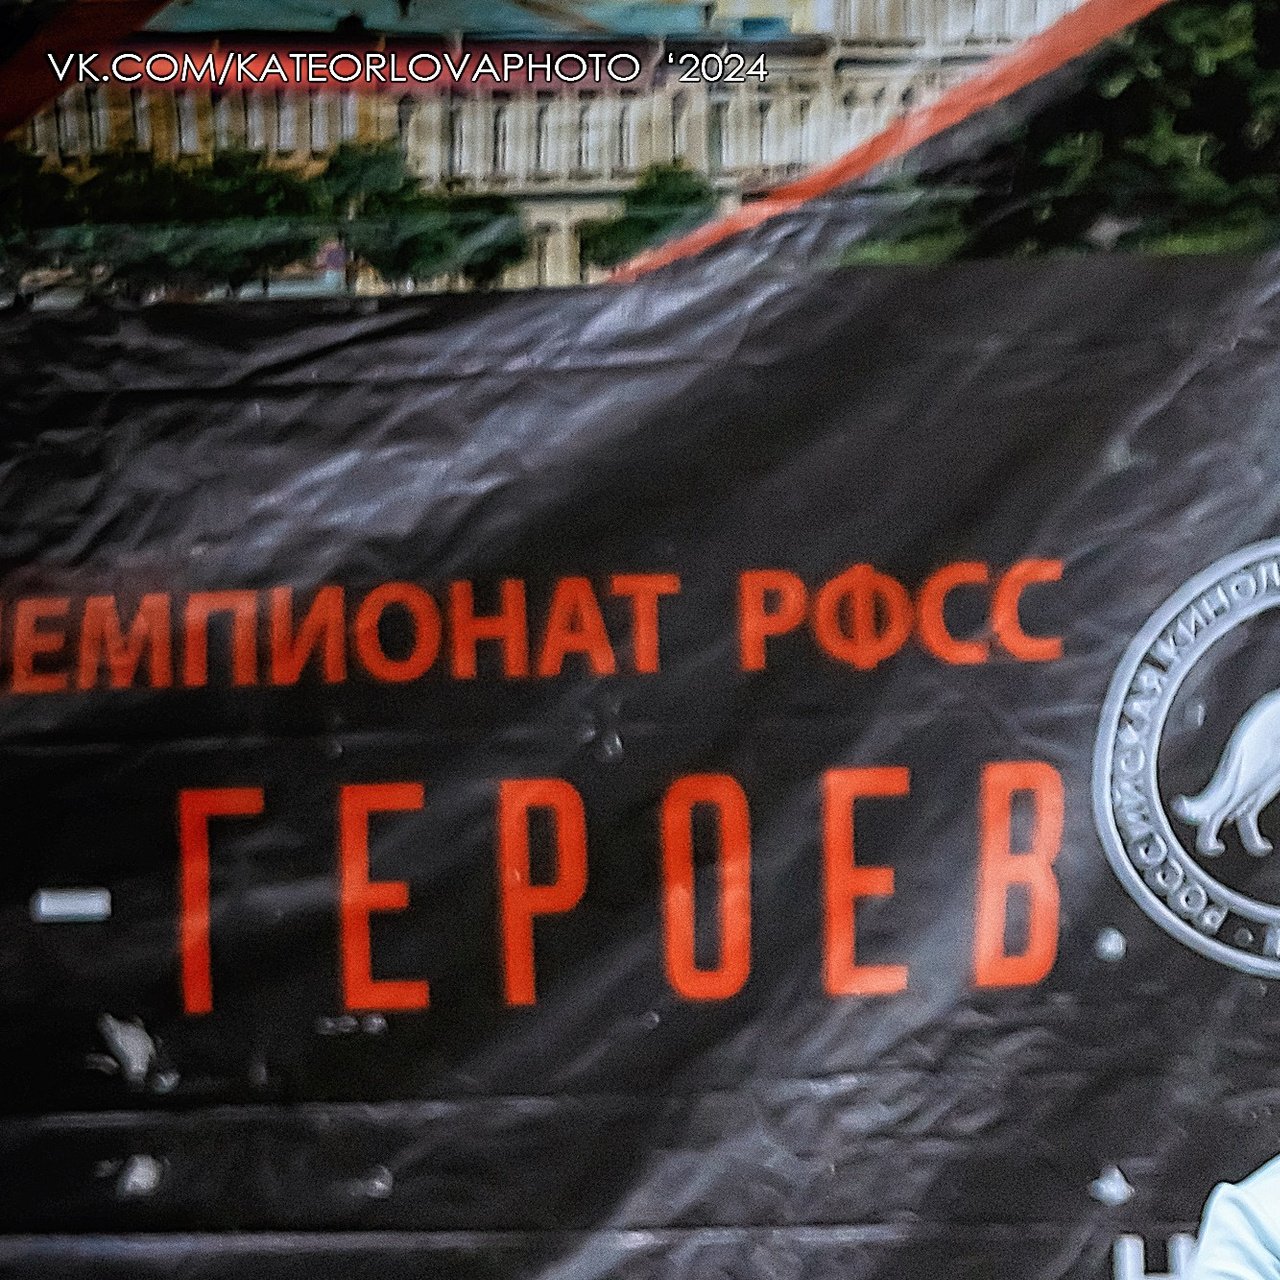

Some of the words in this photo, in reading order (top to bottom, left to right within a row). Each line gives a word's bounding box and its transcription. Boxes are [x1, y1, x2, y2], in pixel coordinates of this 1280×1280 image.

[0, 574, 680, 697] ЕМПИОНАТ
[738, 560, 1066, 672] РФСС
[178, 760, 1066, 1015] ГЕРОЕВ
